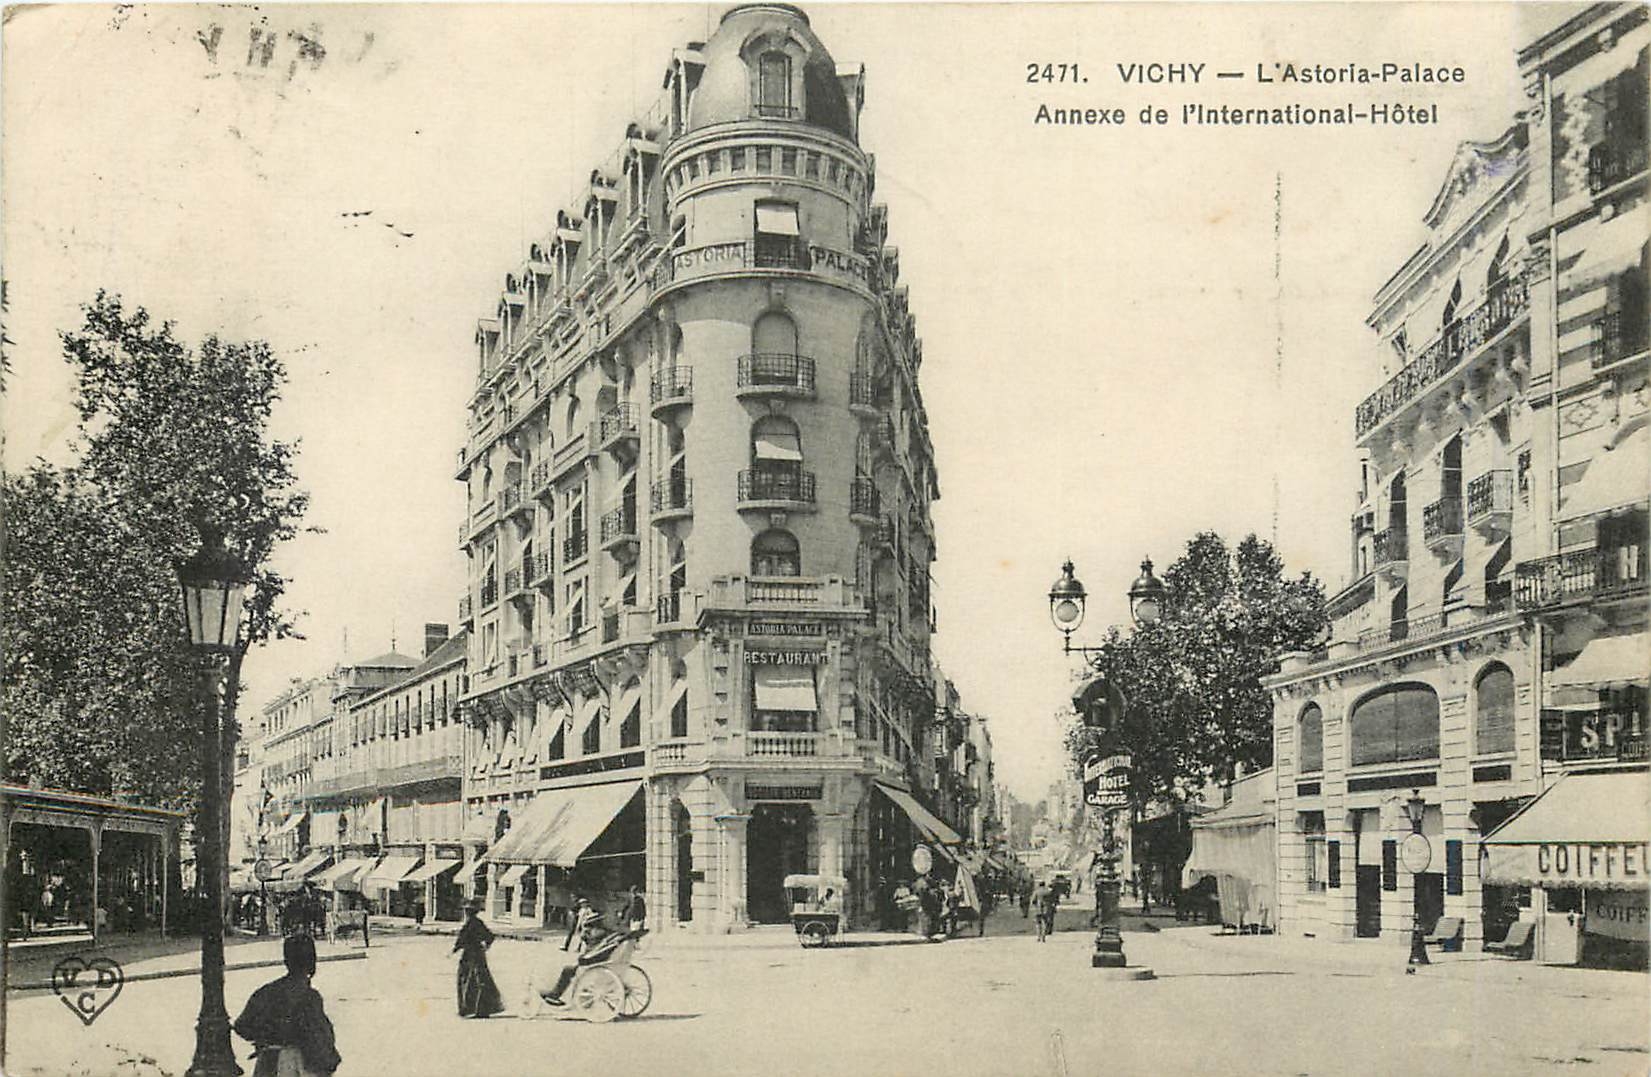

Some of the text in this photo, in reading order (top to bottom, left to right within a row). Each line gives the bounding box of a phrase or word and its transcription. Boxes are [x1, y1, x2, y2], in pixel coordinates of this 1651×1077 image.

[675, 246, 742, 269] ASTORIA
[743, 650, 832, 666] RESTAURANT
[1099, 773, 1131, 790] HOTEL
[1087, 794, 1129, 806] GARAGE
